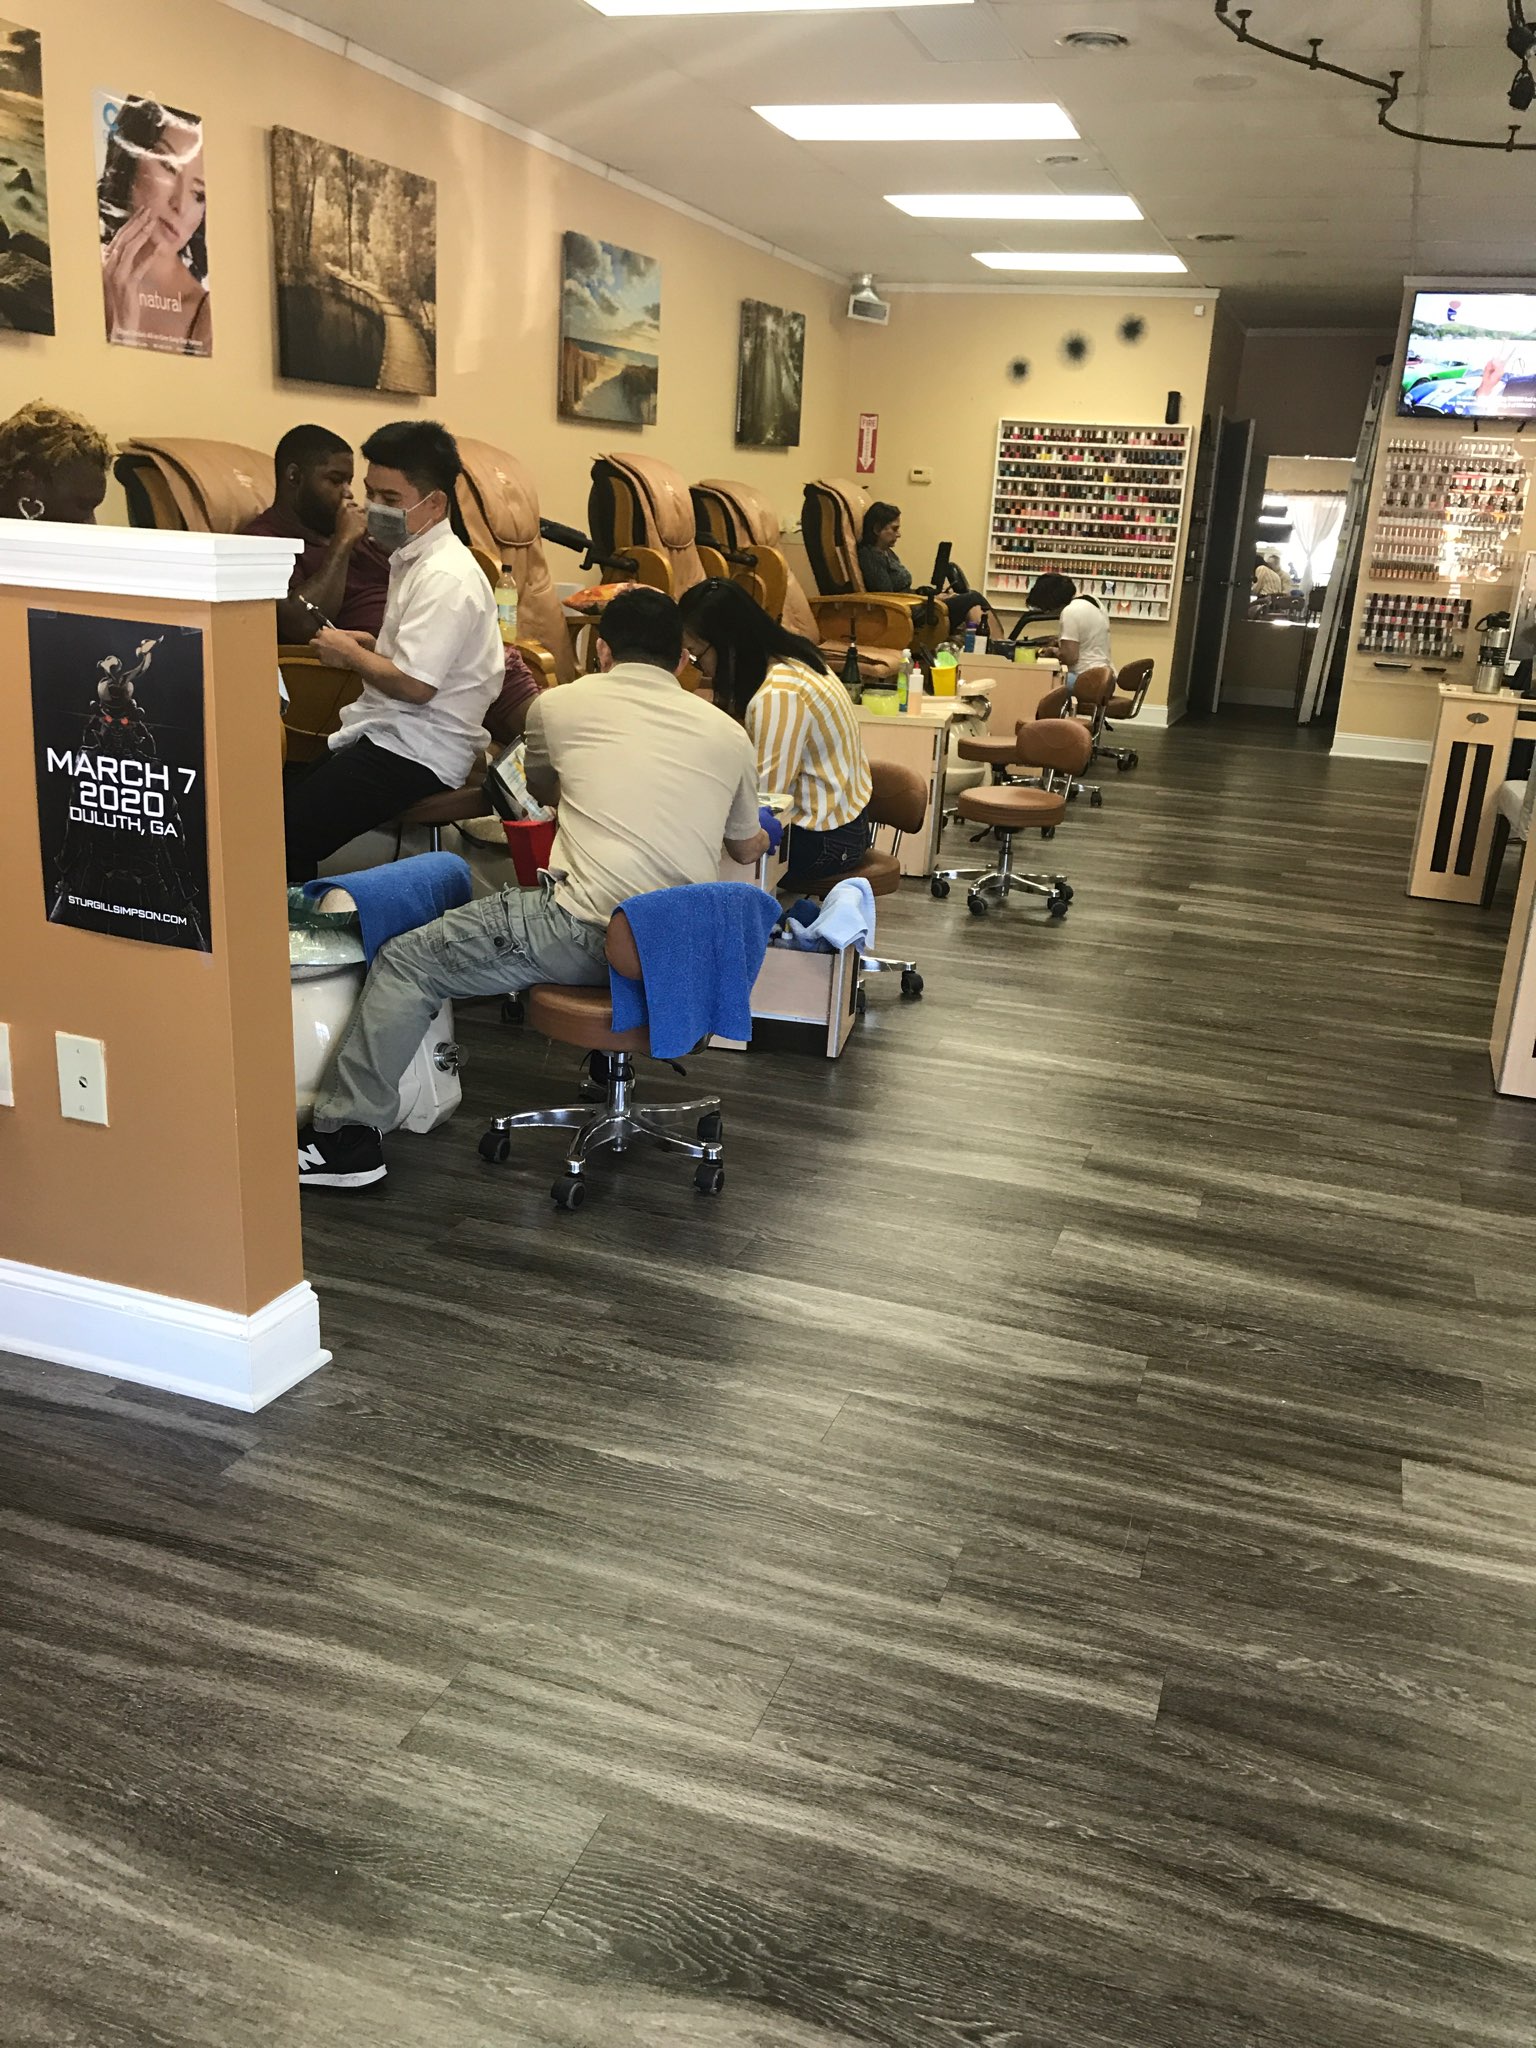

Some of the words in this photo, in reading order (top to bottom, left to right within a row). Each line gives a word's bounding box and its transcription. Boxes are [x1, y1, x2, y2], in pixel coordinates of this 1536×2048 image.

[139, 291, 182, 312] natural
[46, 747, 170, 791] MARCH
[177, 767, 197, 794] 7
[79, 780, 164, 818] 2020
[69, 806, 146, 836] DULUTH,
[150, 820, 178, 838] GA
[68, 895, 188, 926] STURGILLSIMPSON.COM
